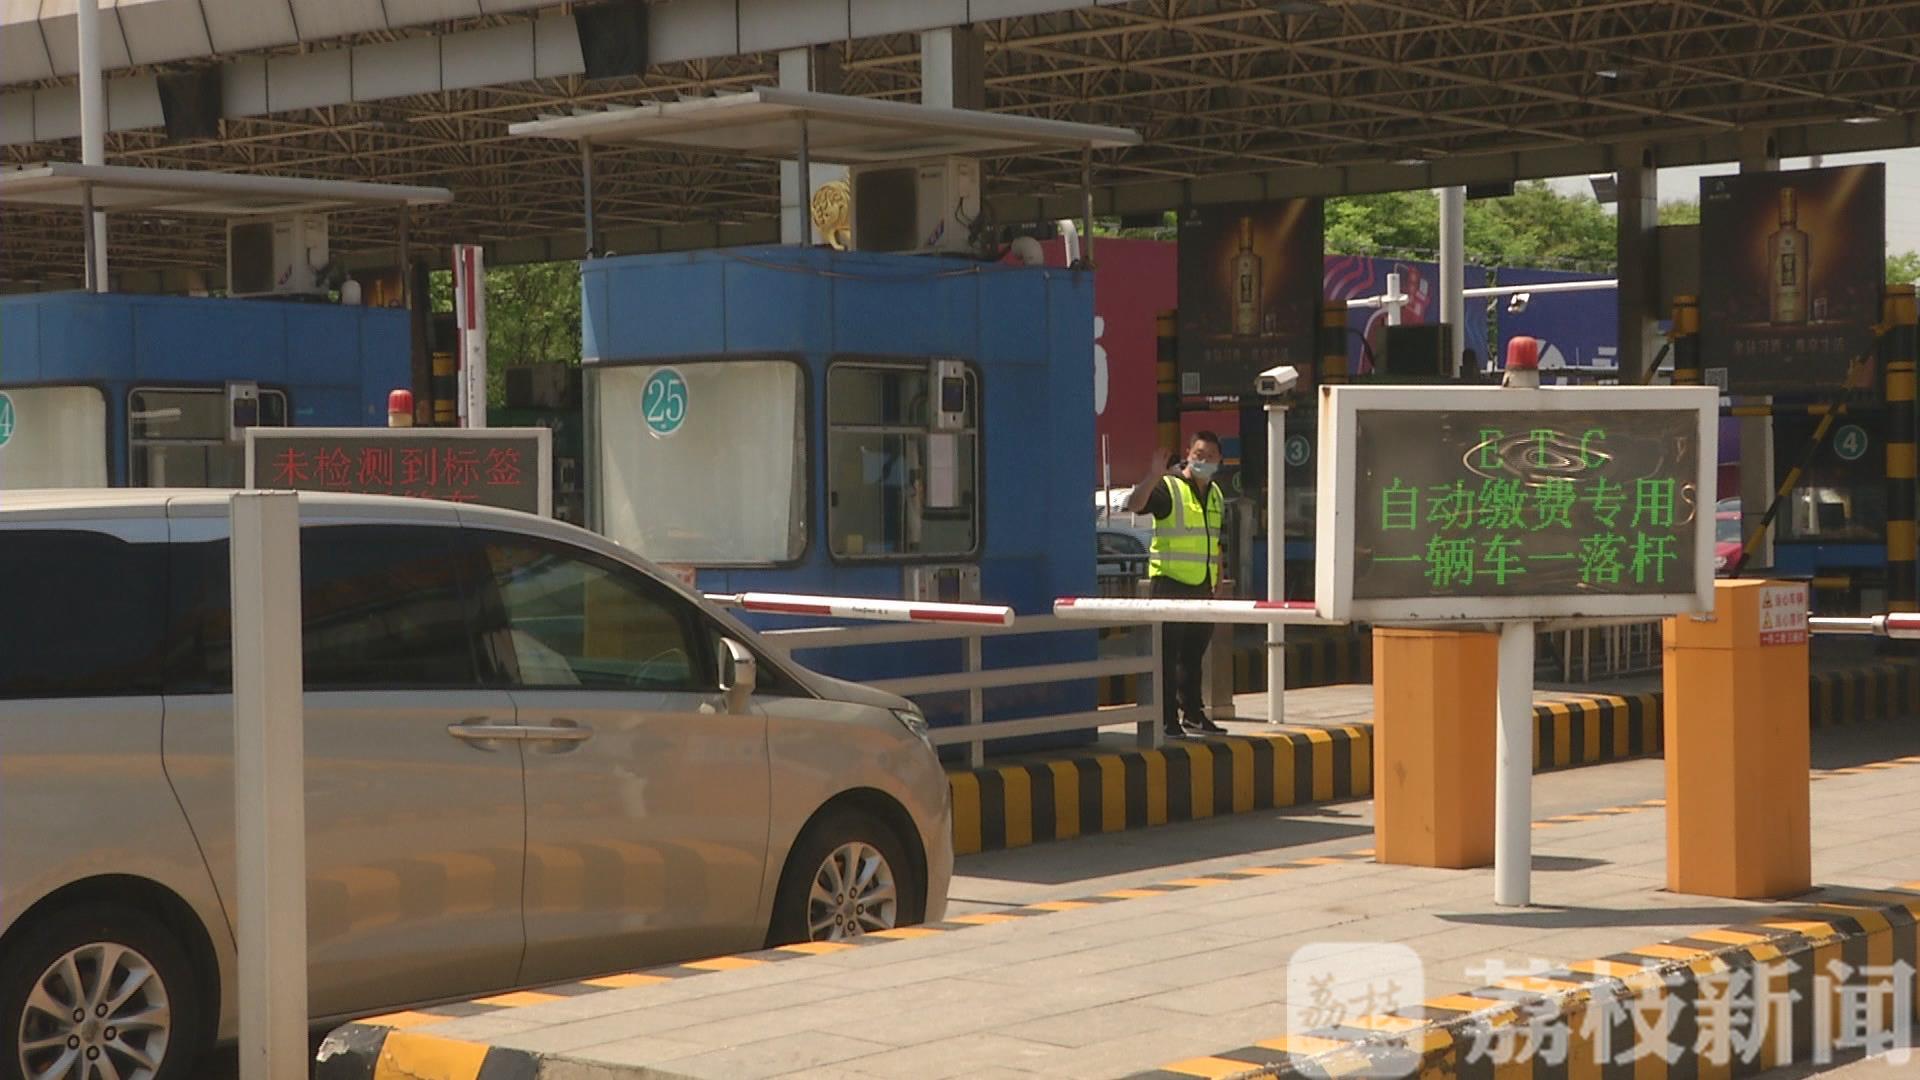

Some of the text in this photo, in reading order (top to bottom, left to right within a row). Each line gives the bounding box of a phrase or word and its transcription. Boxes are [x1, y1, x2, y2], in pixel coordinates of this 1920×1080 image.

[648, 379, 684, 423] 25
[1290, 441, 1304, 461] 3
[1842, 431, 1858, 453] 4
[272, 447, 522, 487] 未检测到标签
[1380, 477, 1676, 531] 自动缴费专用
[1373, 532, 1678, 587] 一辆车一落杆
